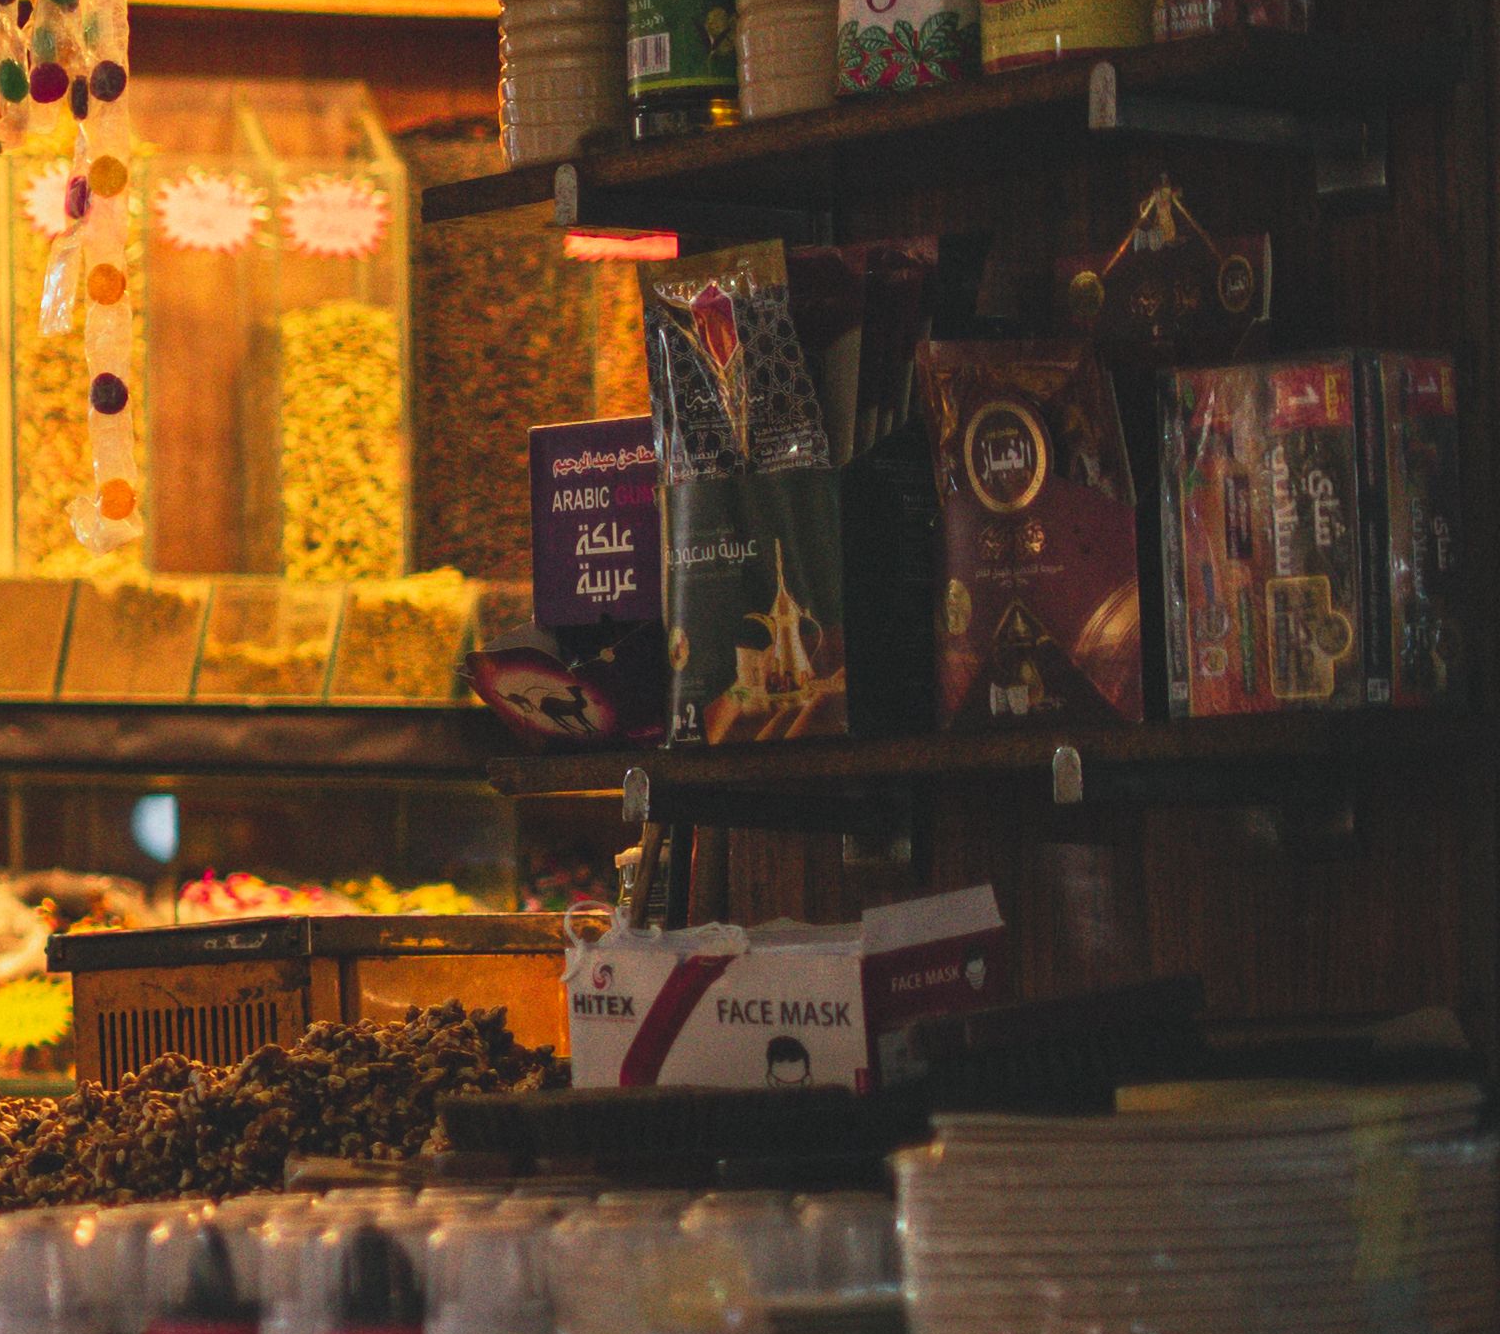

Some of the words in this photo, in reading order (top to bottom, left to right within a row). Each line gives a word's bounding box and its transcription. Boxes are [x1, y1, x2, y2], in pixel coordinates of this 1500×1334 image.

[552, 485, 611, 514] ARABIC
[575, 521, 635, 557] علكة
[575, 561, 638, 603] عربية
[573, 993, 635, 1018] HiTEX
[716, 997, 776, 1027] FACE
[780, 998, 852, 1029] MASK
